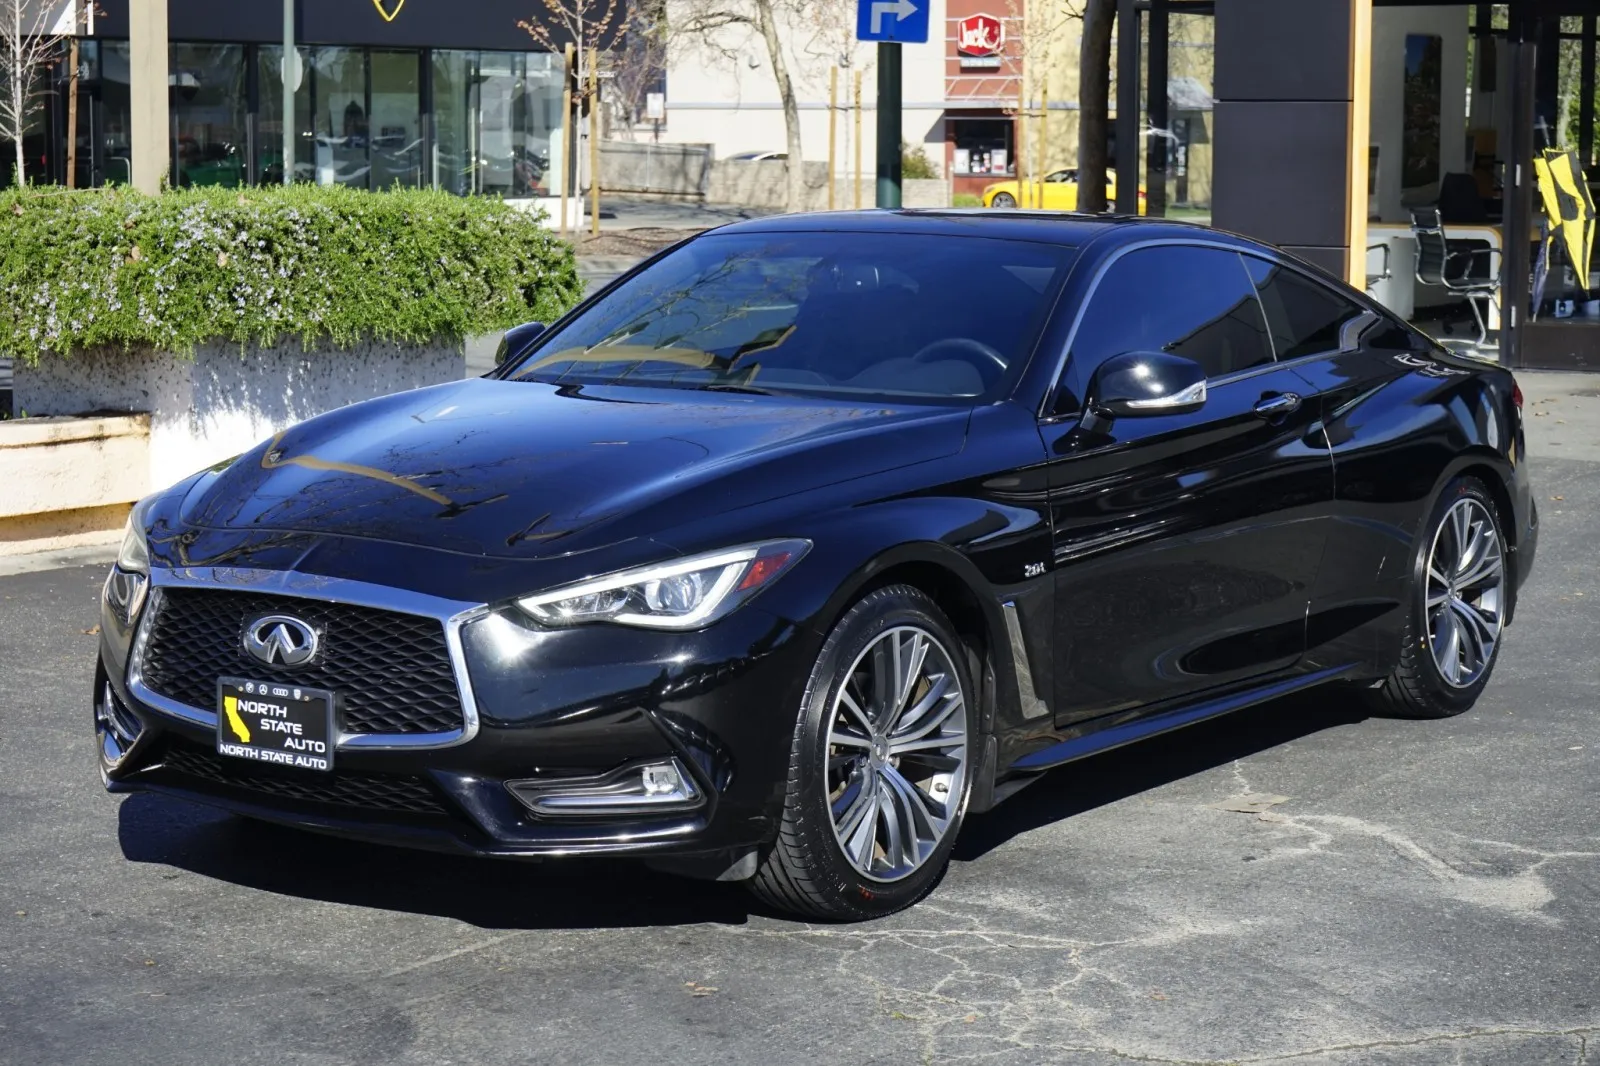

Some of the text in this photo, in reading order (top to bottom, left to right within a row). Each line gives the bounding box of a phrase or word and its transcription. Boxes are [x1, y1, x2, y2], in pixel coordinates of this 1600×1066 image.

[237, 700, 287, 718] NORTH
[261, 719, 302, 735] STATE
[284, 737, 325, 753] AUTO
[220, 744, 327, 769] NORTH STATE AUTO
